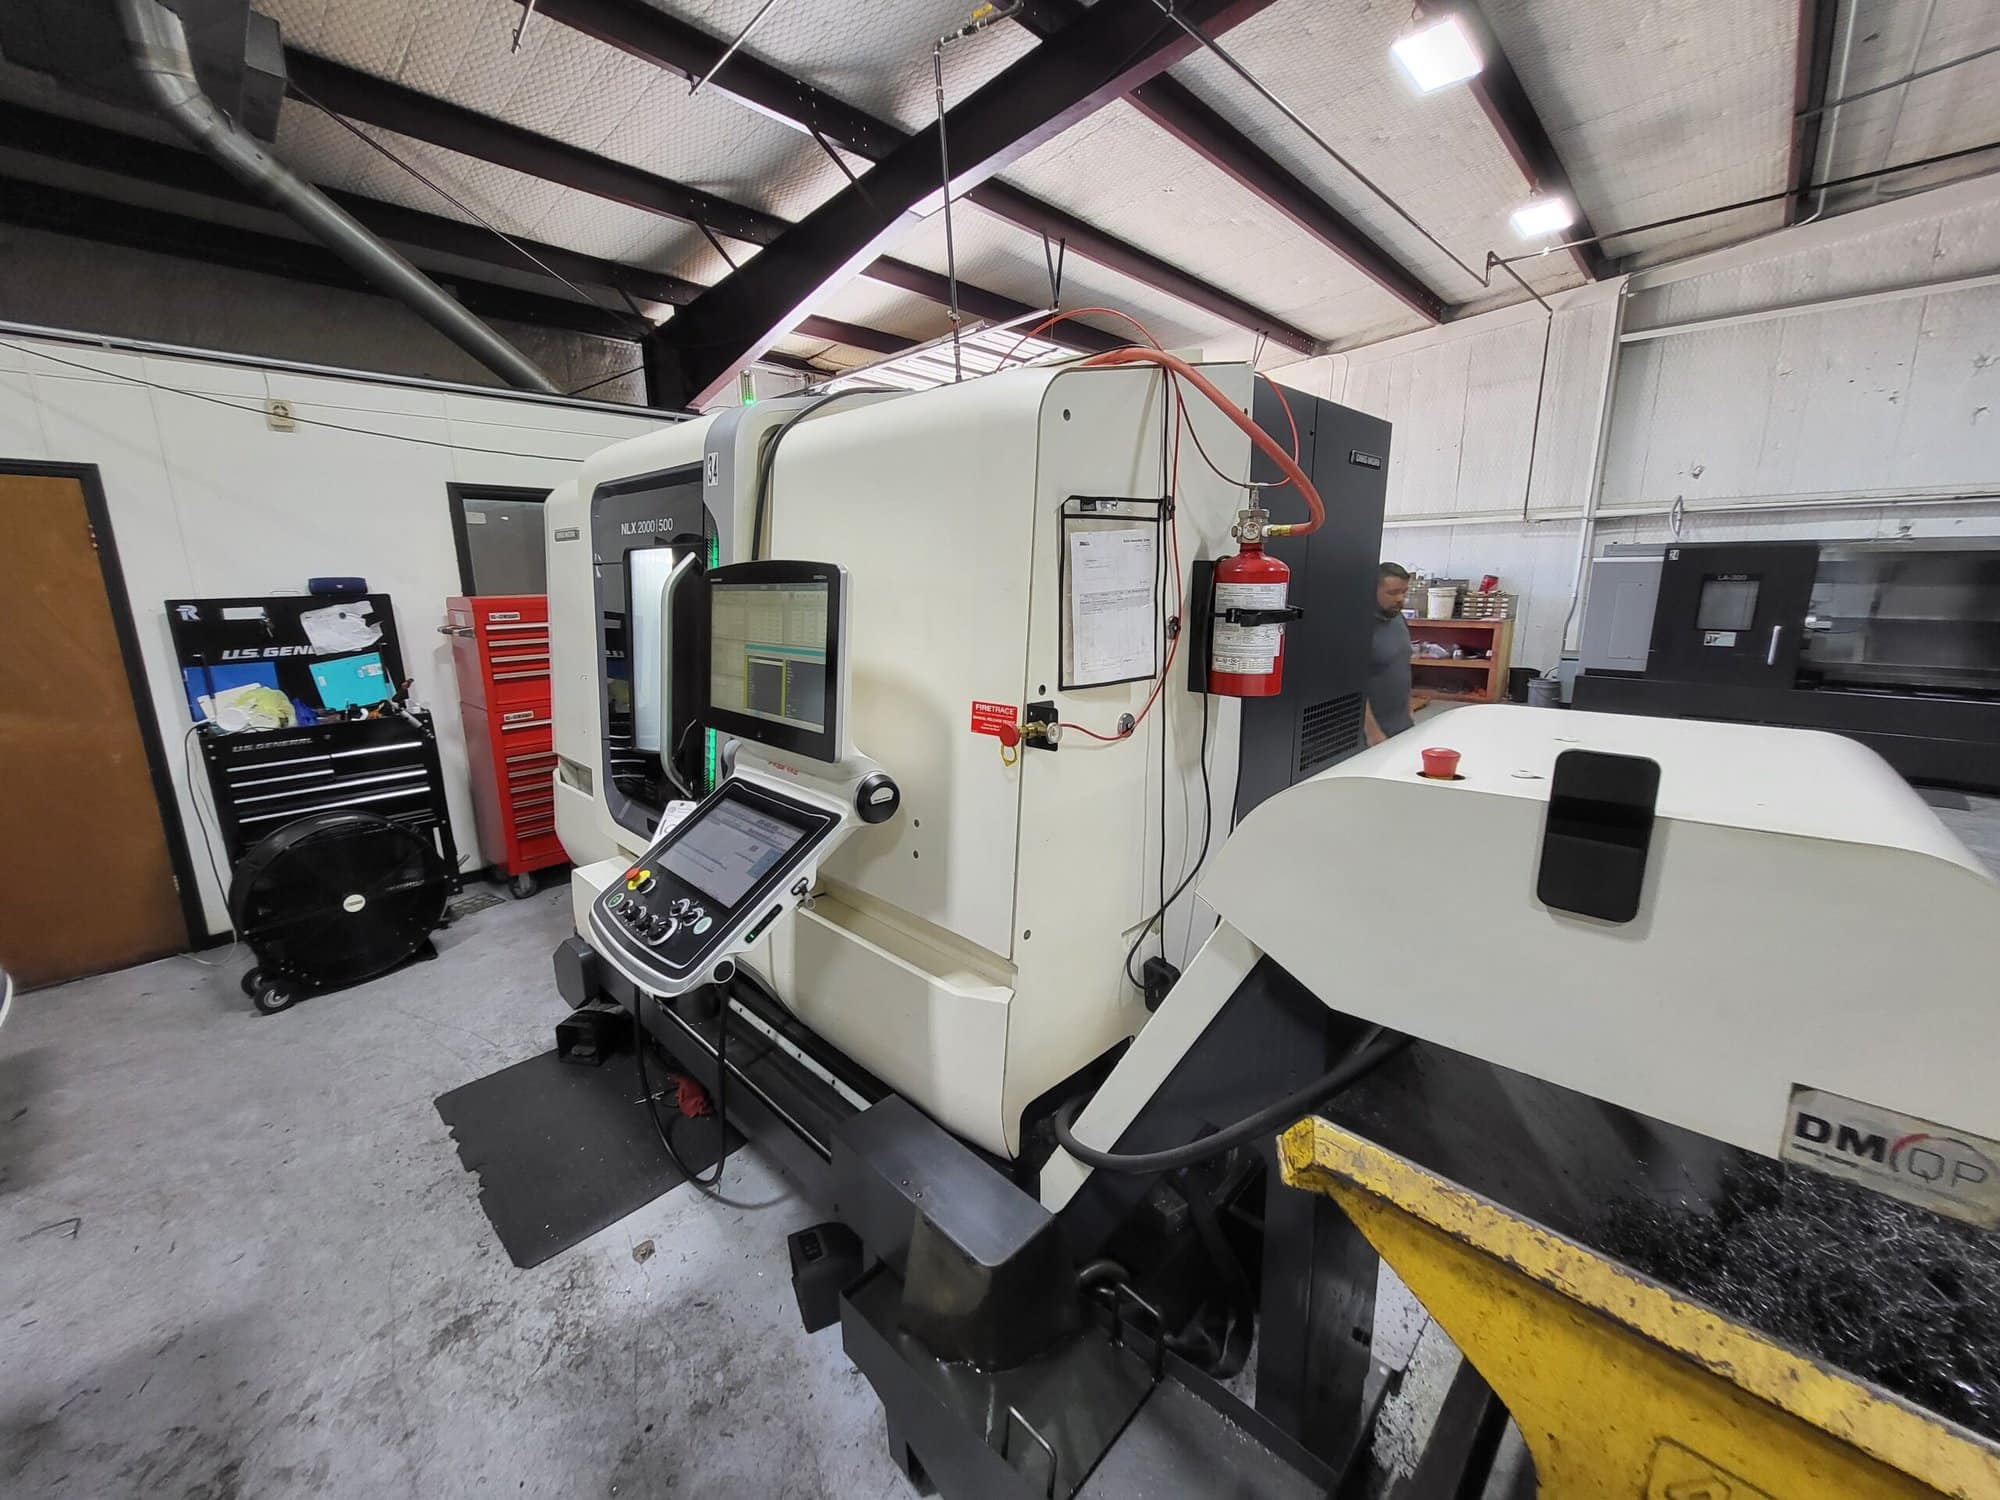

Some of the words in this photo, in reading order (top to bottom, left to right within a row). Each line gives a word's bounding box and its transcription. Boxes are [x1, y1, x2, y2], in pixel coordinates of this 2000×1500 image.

[708, 453, 719, 484] 34
[620, 521, 637, 535] NLX
[975, 703, 1014, 715] FIRETRACE
